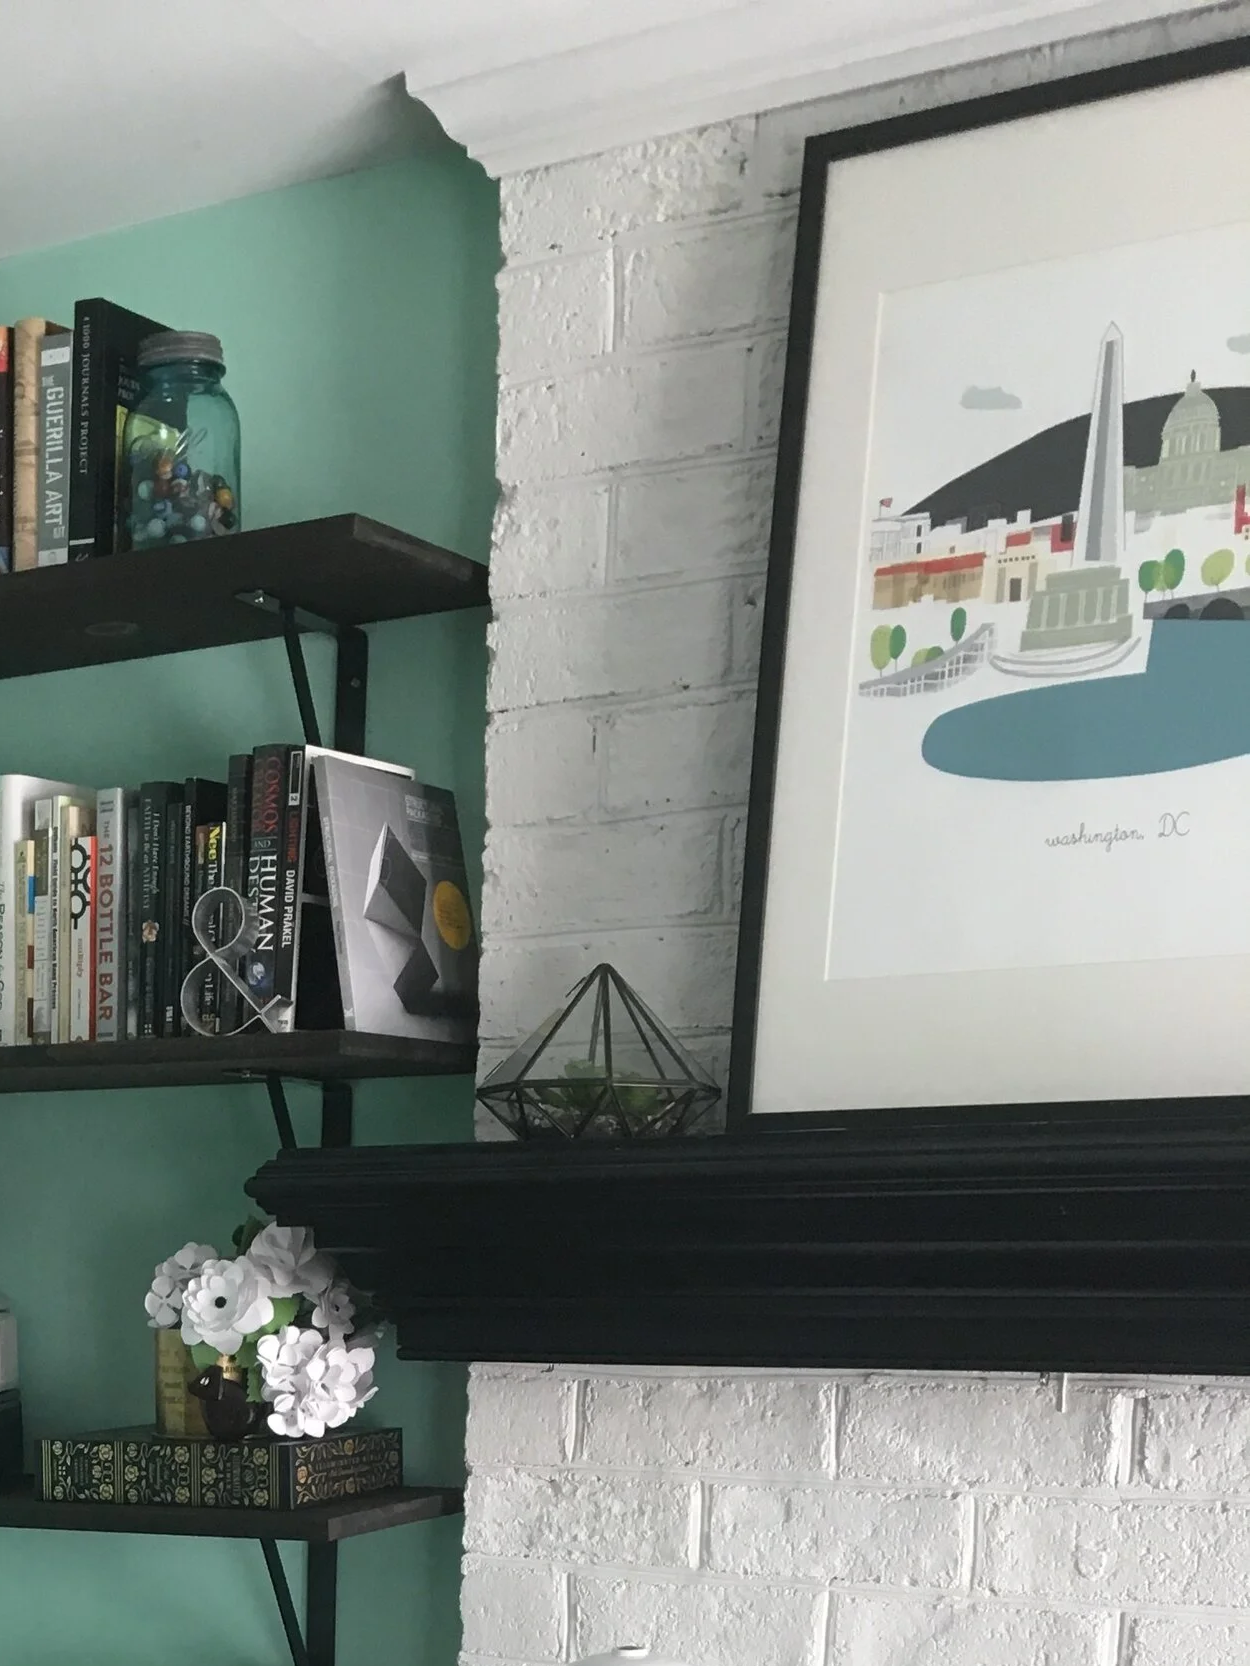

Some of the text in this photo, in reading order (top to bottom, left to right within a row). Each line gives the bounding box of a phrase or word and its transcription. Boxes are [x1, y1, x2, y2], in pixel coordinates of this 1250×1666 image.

[79, 353, 91, 417] JOURNALS
[44, 386, 65, 526] GUERILLA ART
[78, 420, 90, 477] PROJECT
[184, 804, 193, 834] BEYOND
[263, 755, 282, 834] COSMOS
[207, 825, 222, 860] Nee
[285, 811, 299, 863] LIGHTING
[1158, 810, 1190, 839] DC
[207, 860, 219, 887] The
[283, 868, 296, 903] DAVID
[99, 820, 114, 1020] THE 12 BOTTLE BAR
[257, 853, 278, 953] HUMAN
